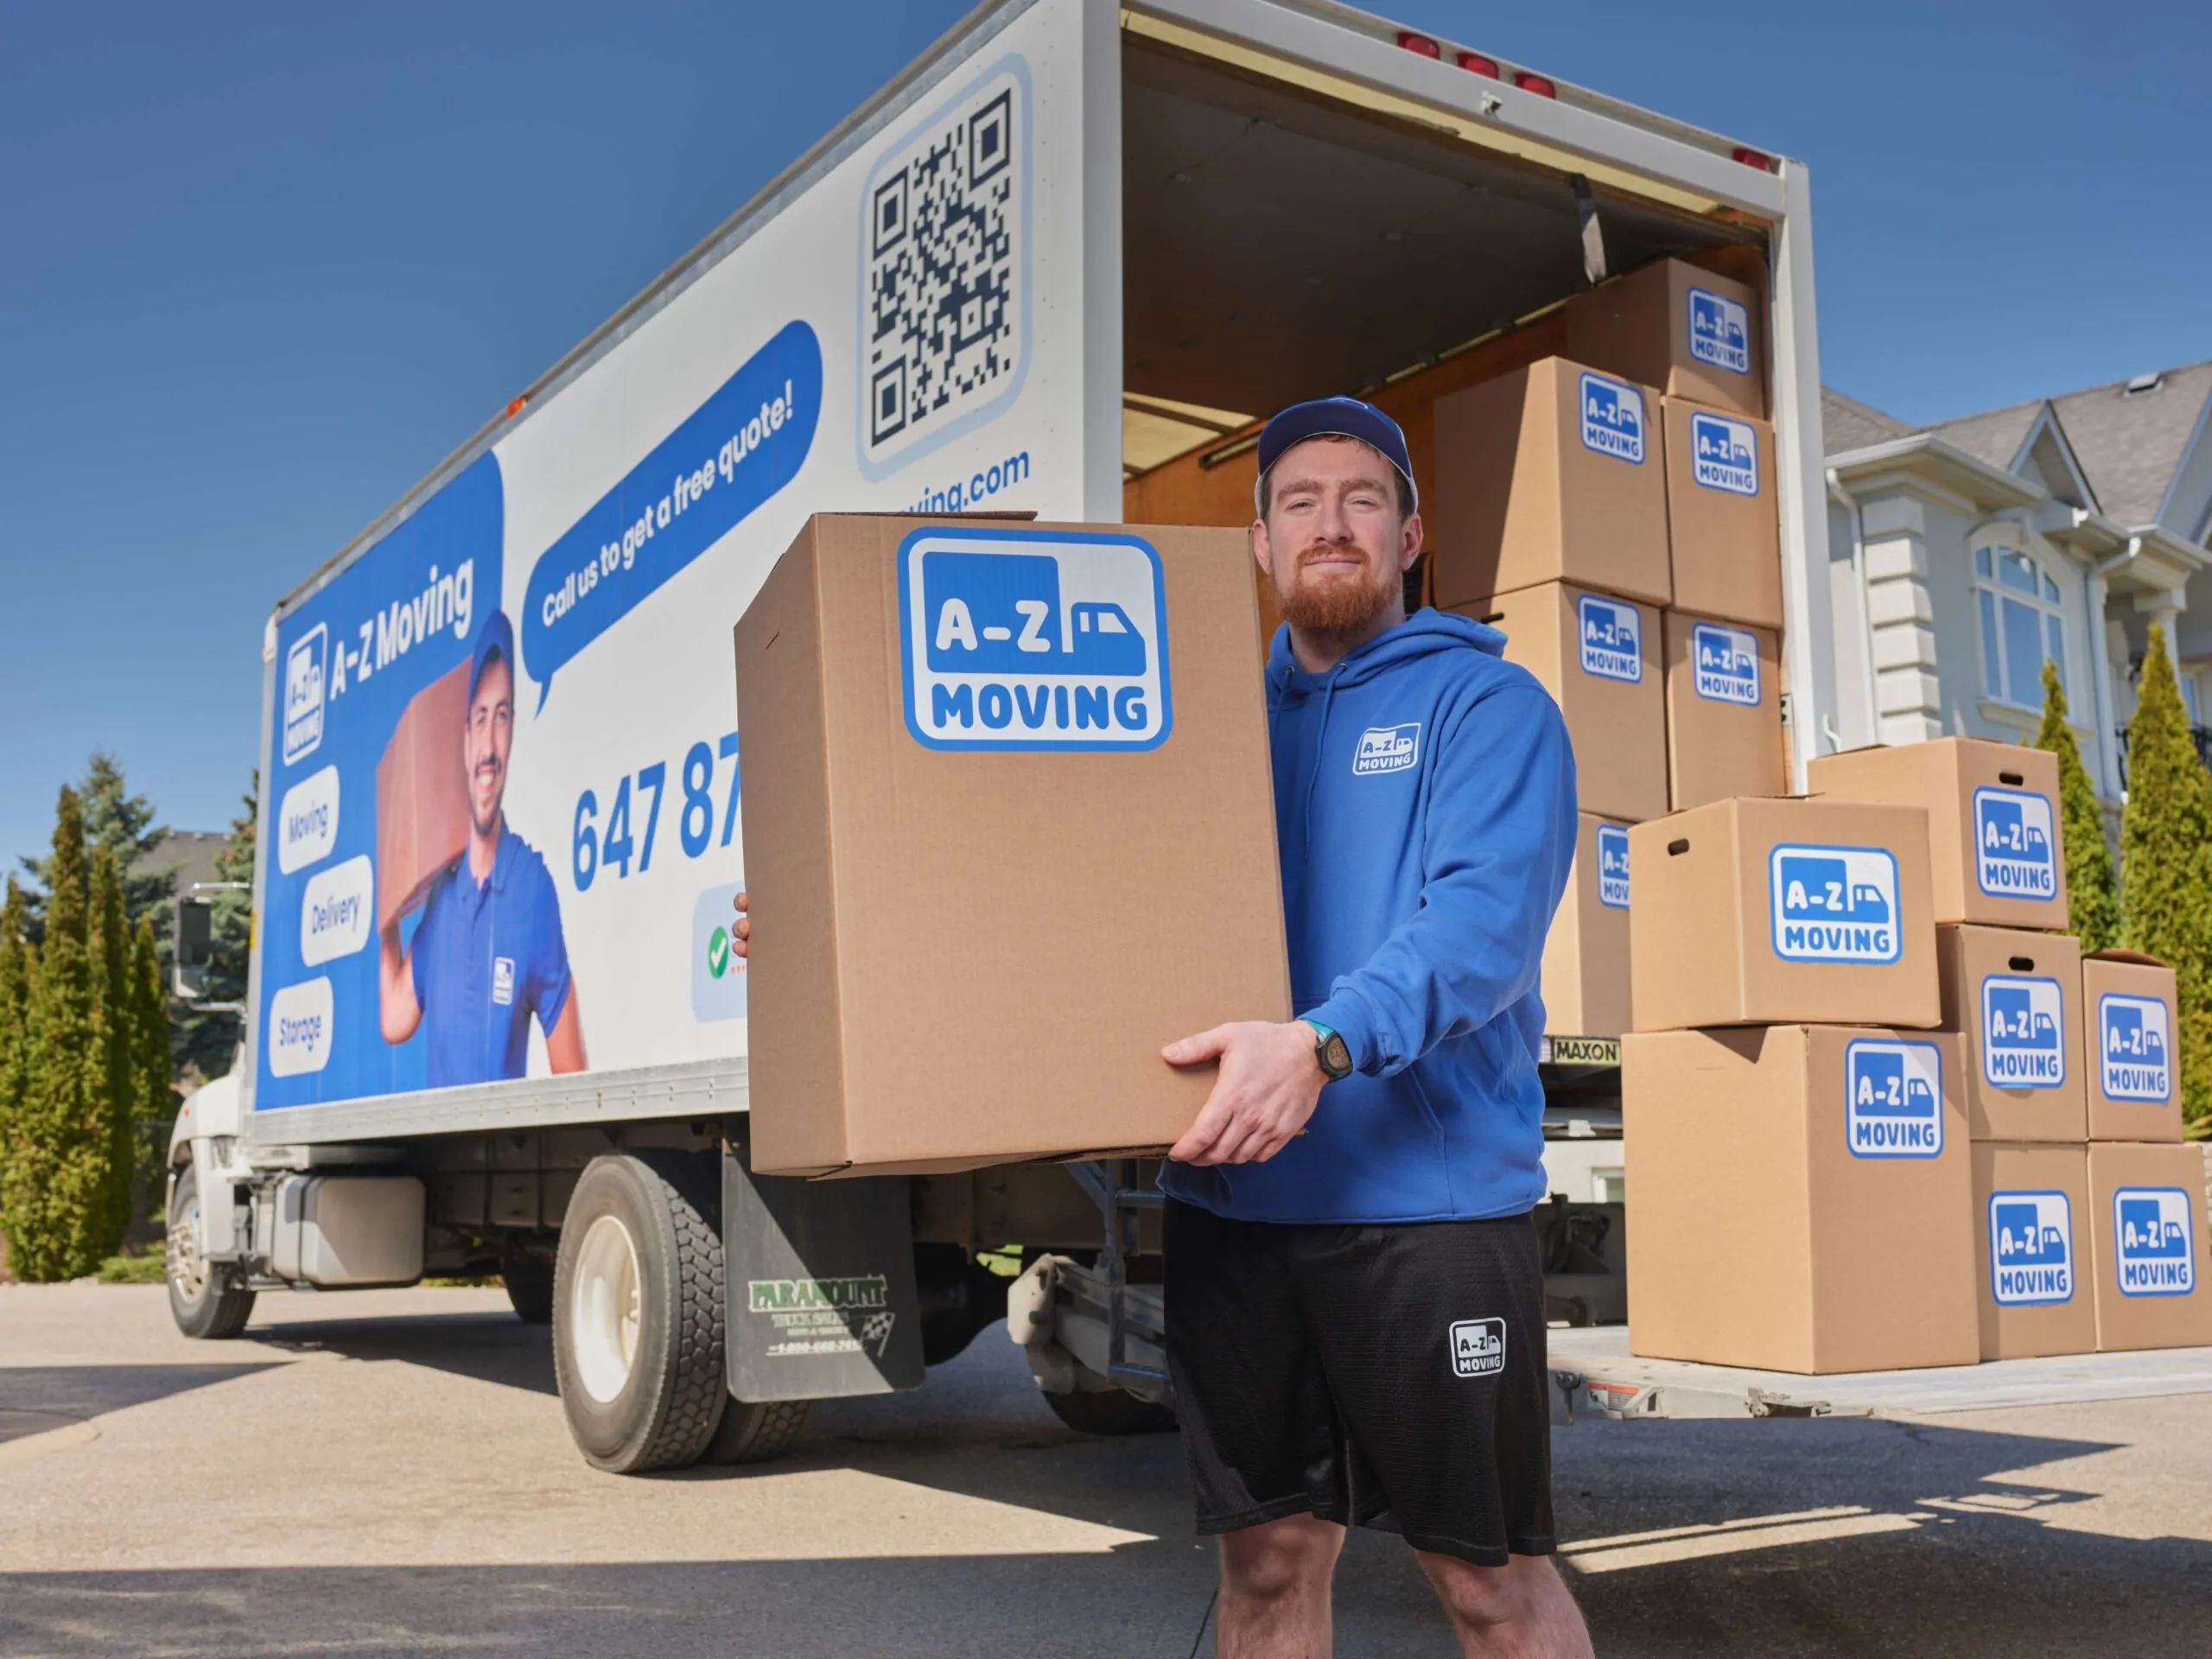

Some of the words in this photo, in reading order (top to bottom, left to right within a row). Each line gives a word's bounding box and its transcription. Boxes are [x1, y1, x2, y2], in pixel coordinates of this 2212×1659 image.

[1695, 312, 1726, 336] A-Z
[1694, 338, 1745, 368] MOVING
[1587, 397, 1617, 424] A-Z
[1587, 426, 1639, 457] MOVING
[1699, 435, 1730, 459] A-Z
[1700, 464, 1753, 490] MOVING
[542, 572, 575, 626] Call
[577, 560, 599, 598] us
[600, 541, 620, 577] to
[622, 505, 654, 570] get
[656, 495, 671, 529] a
[673, 459, 715, 516] free
[718, 378, 793, 484] quote!
[329, 619, 373, 702] A-Z
[376, 557, 474, 671] Moving
[935, 598, 1051, 652] A-Z
[1586, 620, 1616, 645] A-Z
[1586, 651, 1637, 677] MOVING
[1701, 646, 1731, 671] A-Z
[1700, 676, 1755, 699] MOVING
[931, 683, 1147, 731] MOVING
[1363, 741, 1392, 753] A-Z
[1359, 753, 1411, 771] MOVING
[289, 801, 328, 845] Moving
[572, 760, 666, 892] 647
[1985, 821, 2022, 851] A-Z
[1985, 863, 2050, 891] MOVING
[1786, 880, 1843, 912] A-Z
[311, 893, 360, 935] Delivery
[1784, 925, 1891, 953] MOVING
[279, 1014, 322, 1053] Storage
[1993, 1010, 2029, 1038] A-Z
[1556, 1041, 1617, 1061] MAXON
[2109, 1027, 2142, 1055] A-Z
[1991, 1053, 2058, 1077] MOVING
[1857, 1076, 1900, 1106] A-Z
[2108, 1068, 2166, 1093] MOVING
[1855, 1122, 1936, 1147] MOVING
[1999, 1227, 2036, 1255] A-Z
[2125, 1221, 2159, 1249] A-Z
[1999, 1269, 2068, 1294] MOVING
[2125, 1263, 2188, 1286] MOVING
[748, 1274, 887, 1313] PARAMOUNT
[1460, 1337, 1486, 1352] A-Z
[1459, 1356, 1501, 1372] MOVING
